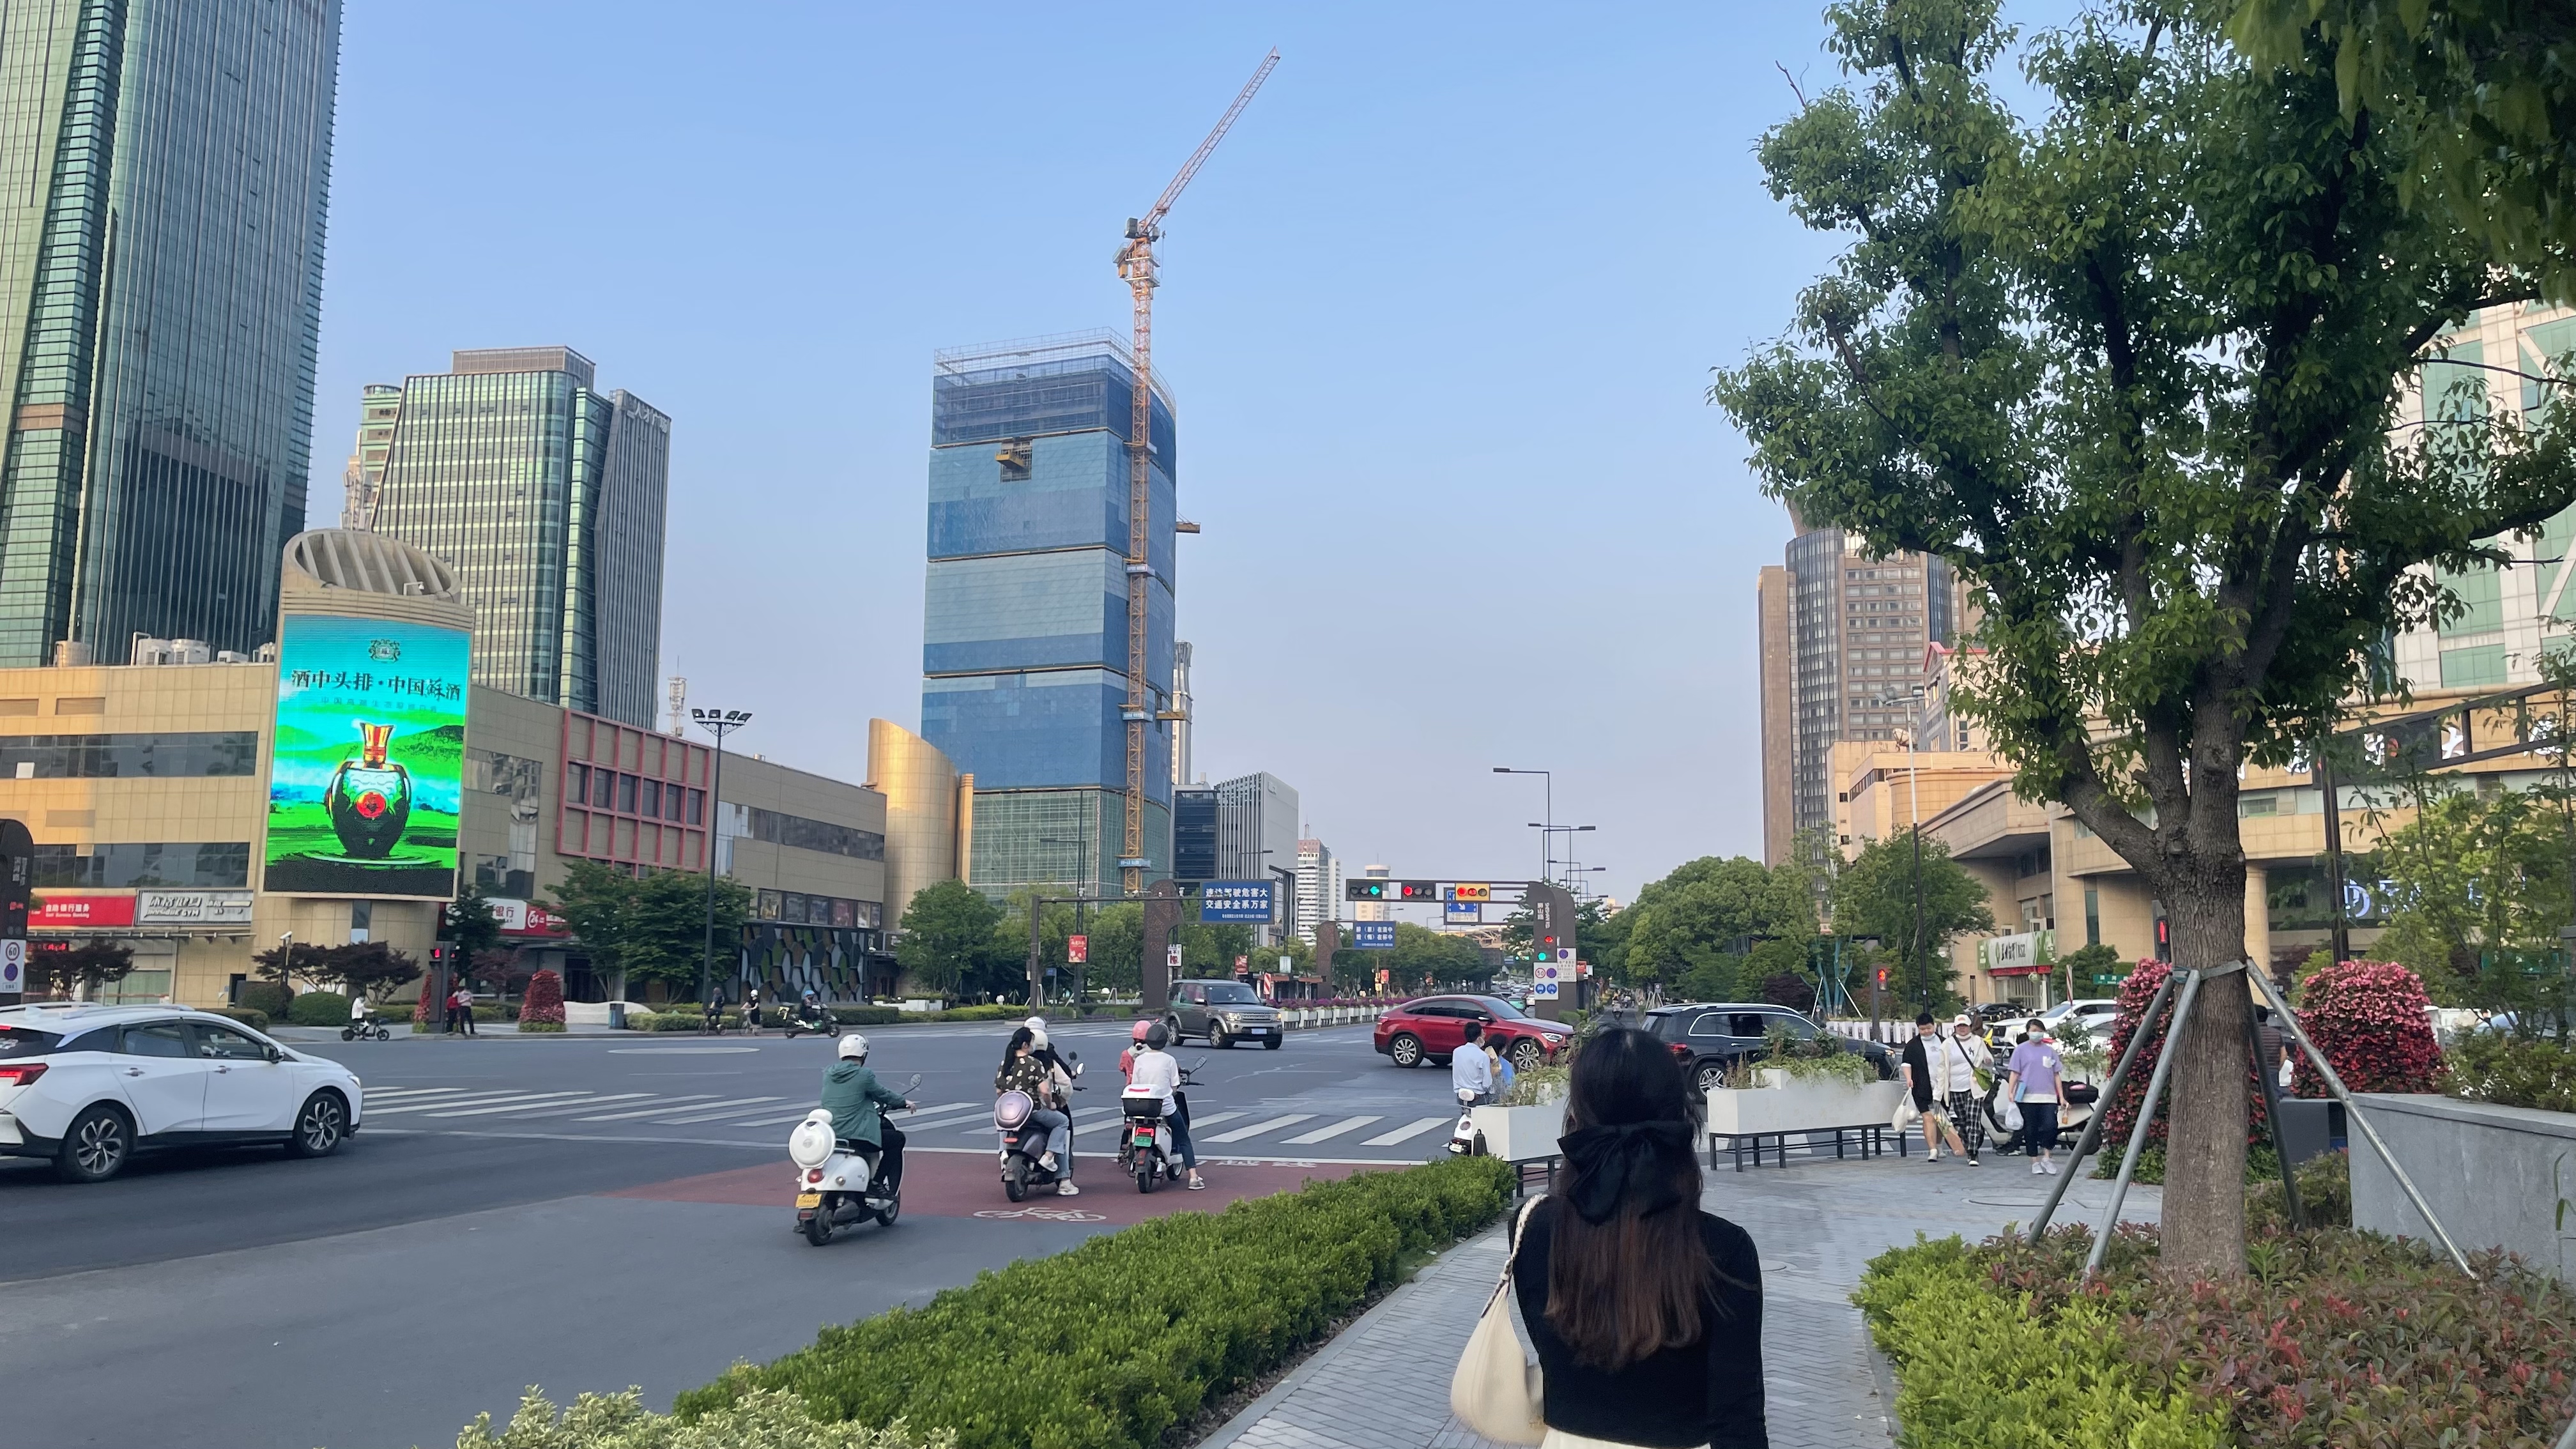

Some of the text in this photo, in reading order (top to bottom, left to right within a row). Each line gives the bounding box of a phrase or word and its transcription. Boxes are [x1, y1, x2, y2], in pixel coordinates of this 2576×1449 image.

[1206, 900, 1268, 909] 交通安全系万家
[8, 947, 17, 956] 60
